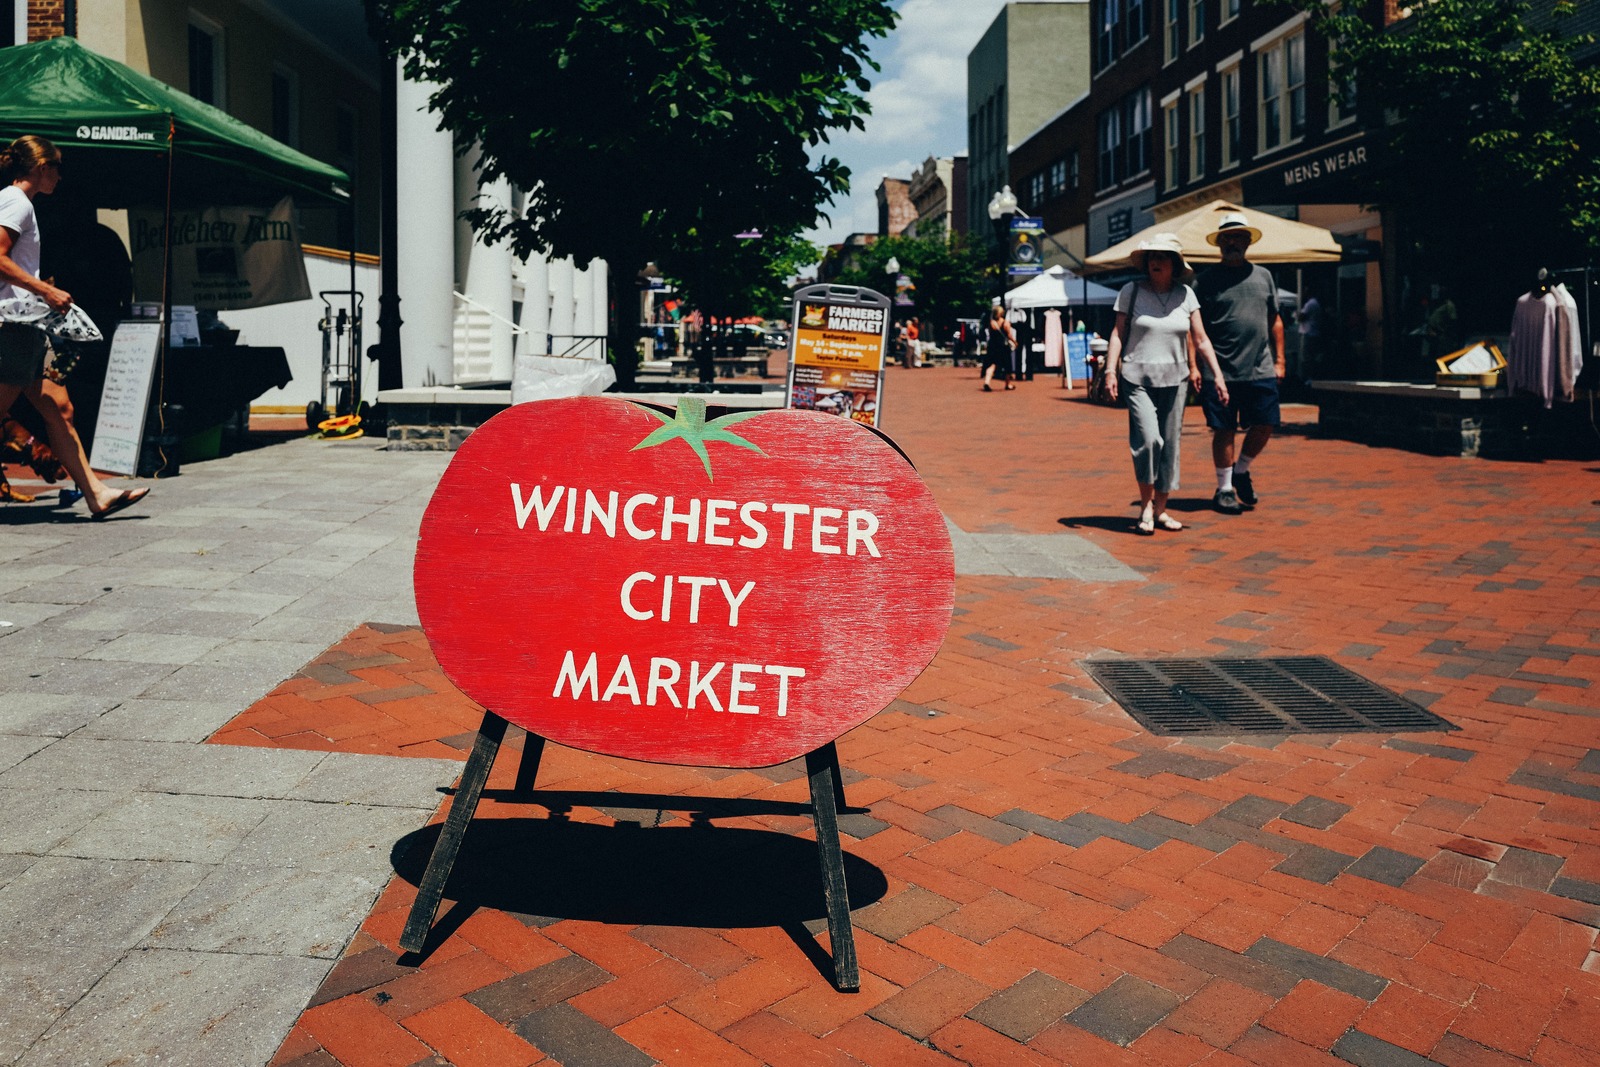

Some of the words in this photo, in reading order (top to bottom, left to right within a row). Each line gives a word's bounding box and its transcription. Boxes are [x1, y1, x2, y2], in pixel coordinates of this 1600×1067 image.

[91, 126, 138, 140] GANDER
[1283, 160, 1321, 186] MENS
[1323, 146, 1367, 174] WEAR
[829, 306, 883, 321] FARMERS
[828, 317, 882, 333] MARKET
[800, 338, 814, 347] May
[829, 341, 867, 351] September
[822, 333, 857, 342] Saturdays
[510, 483, 881, 558] WINCHESTER
[620, 571, 756, 627] CITY
[552, 650, 806, 717] MARKET
